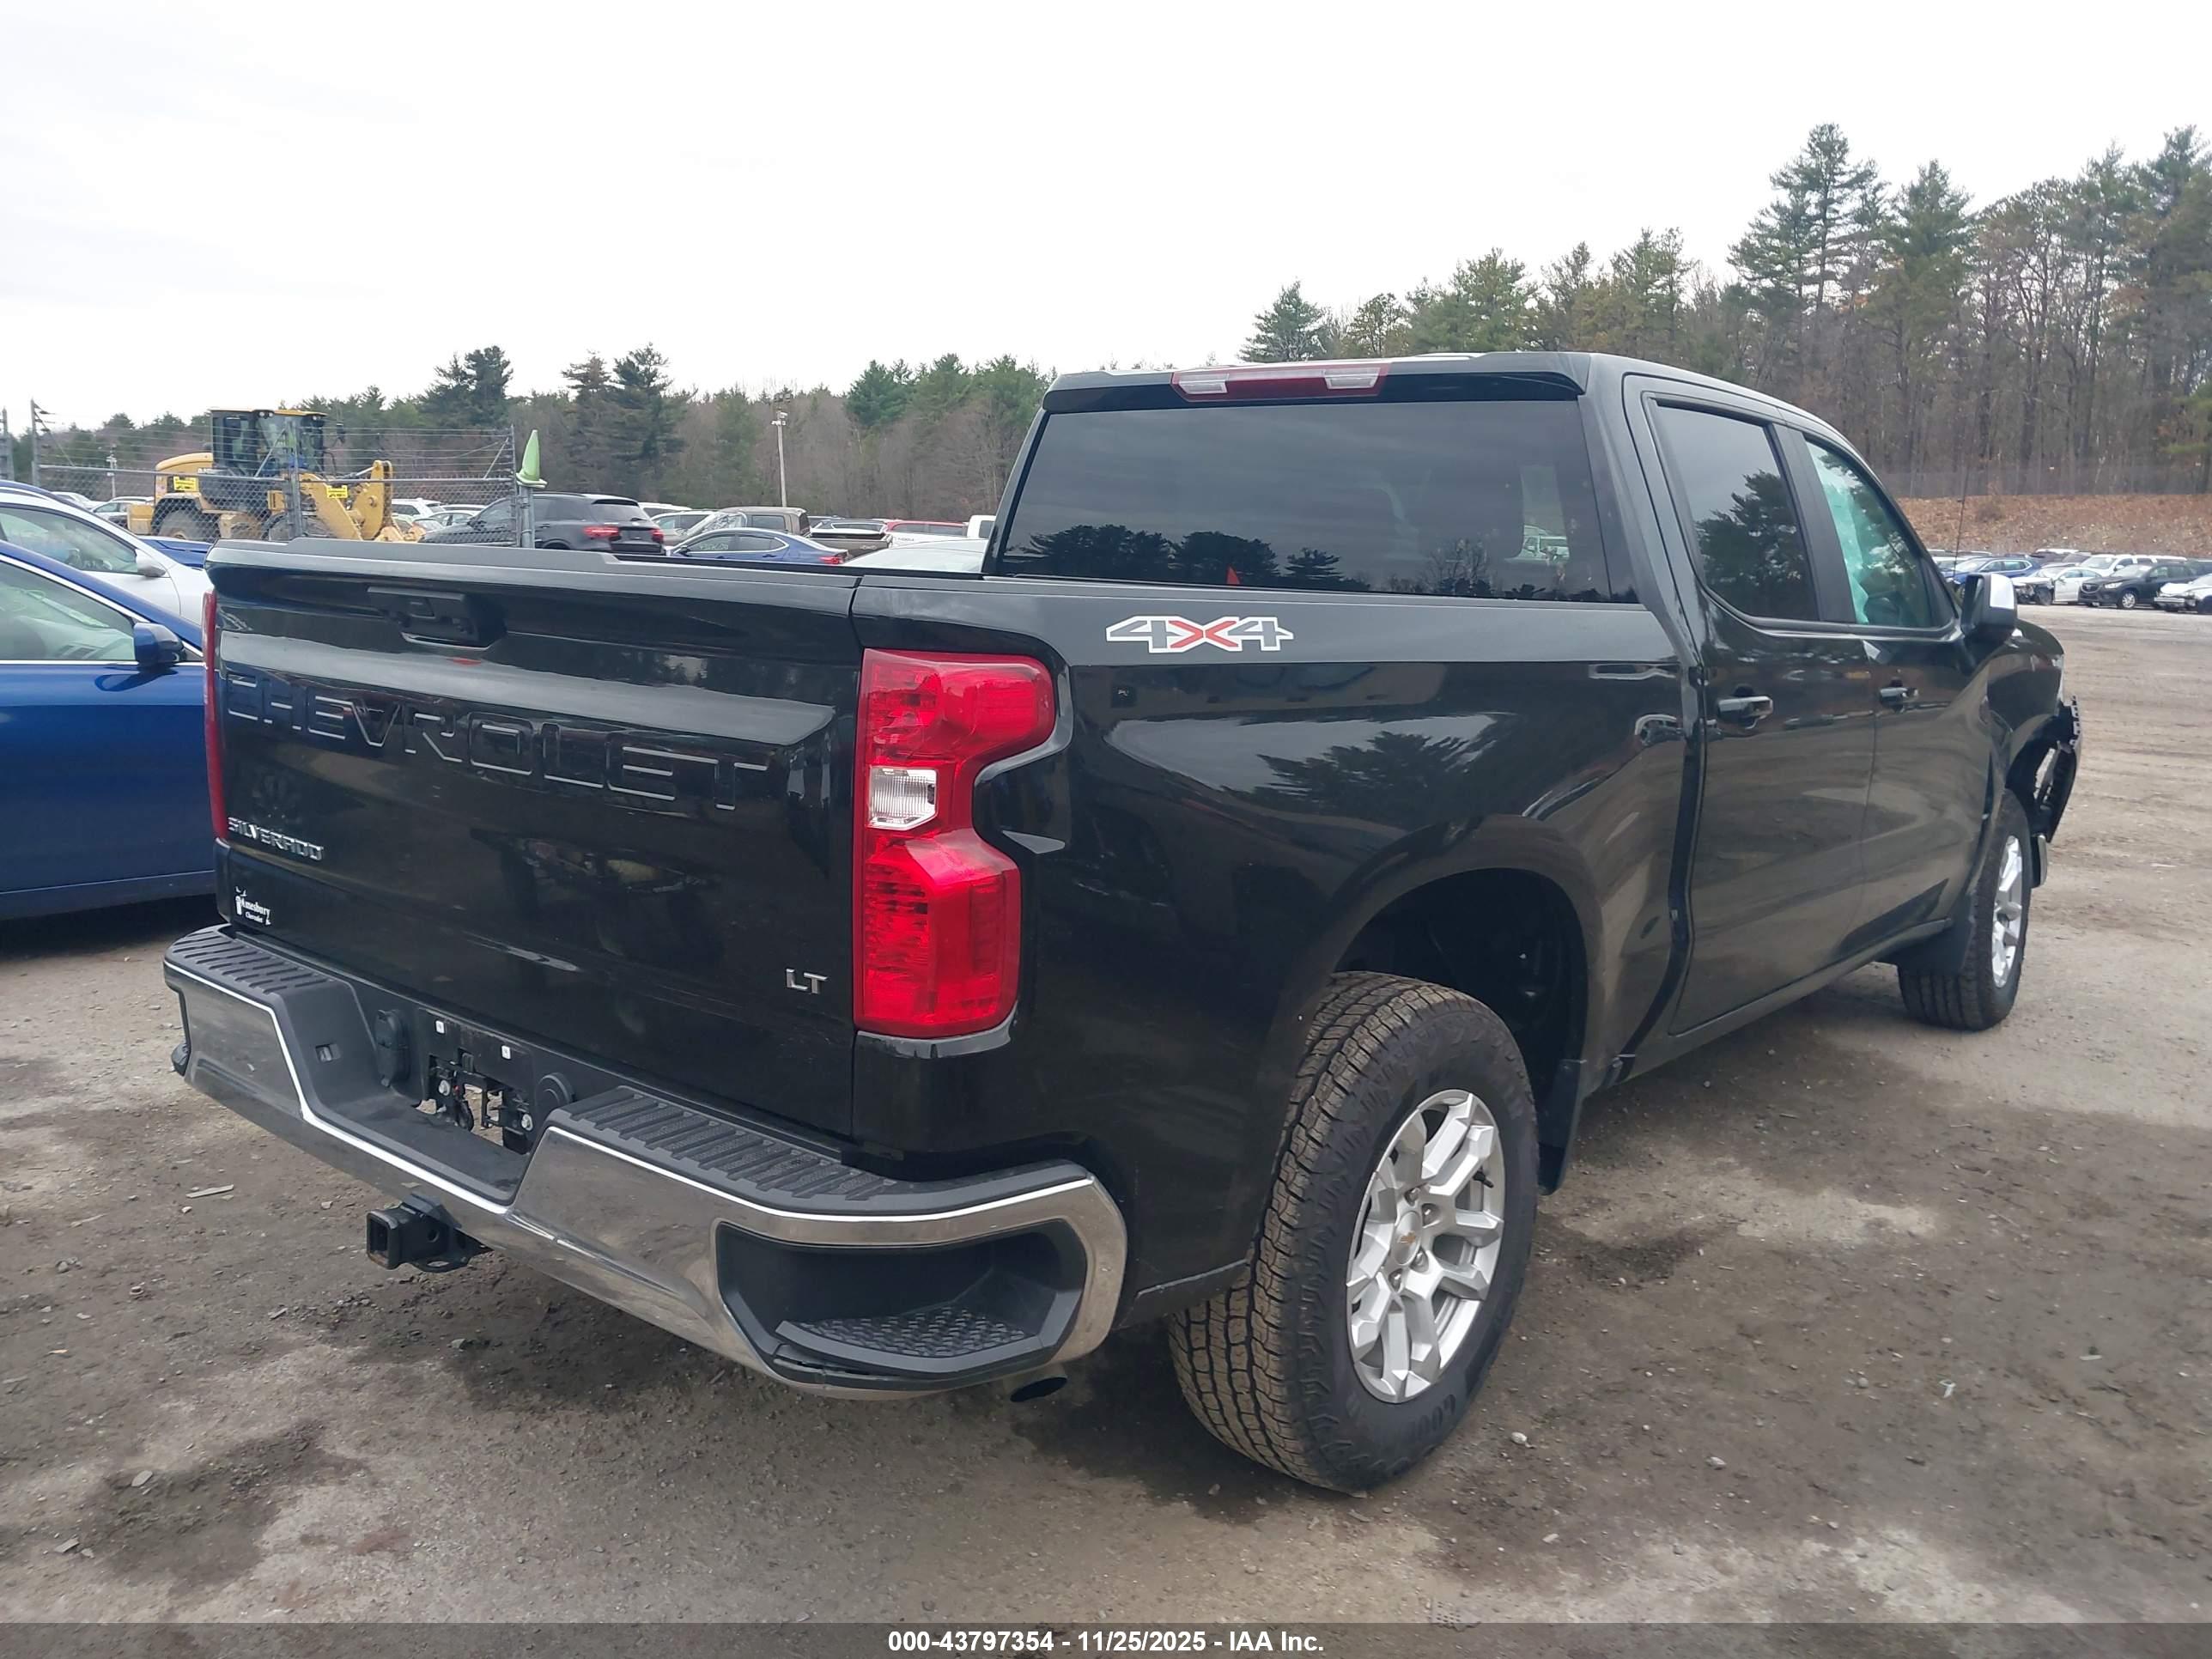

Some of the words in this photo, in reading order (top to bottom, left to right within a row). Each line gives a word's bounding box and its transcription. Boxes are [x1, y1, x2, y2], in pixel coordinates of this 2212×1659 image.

[226, 673, 769, 810] CHEVROLET
[228, 817, 324, 861] SILVERADO
[786, 968, 829, 994] LT
